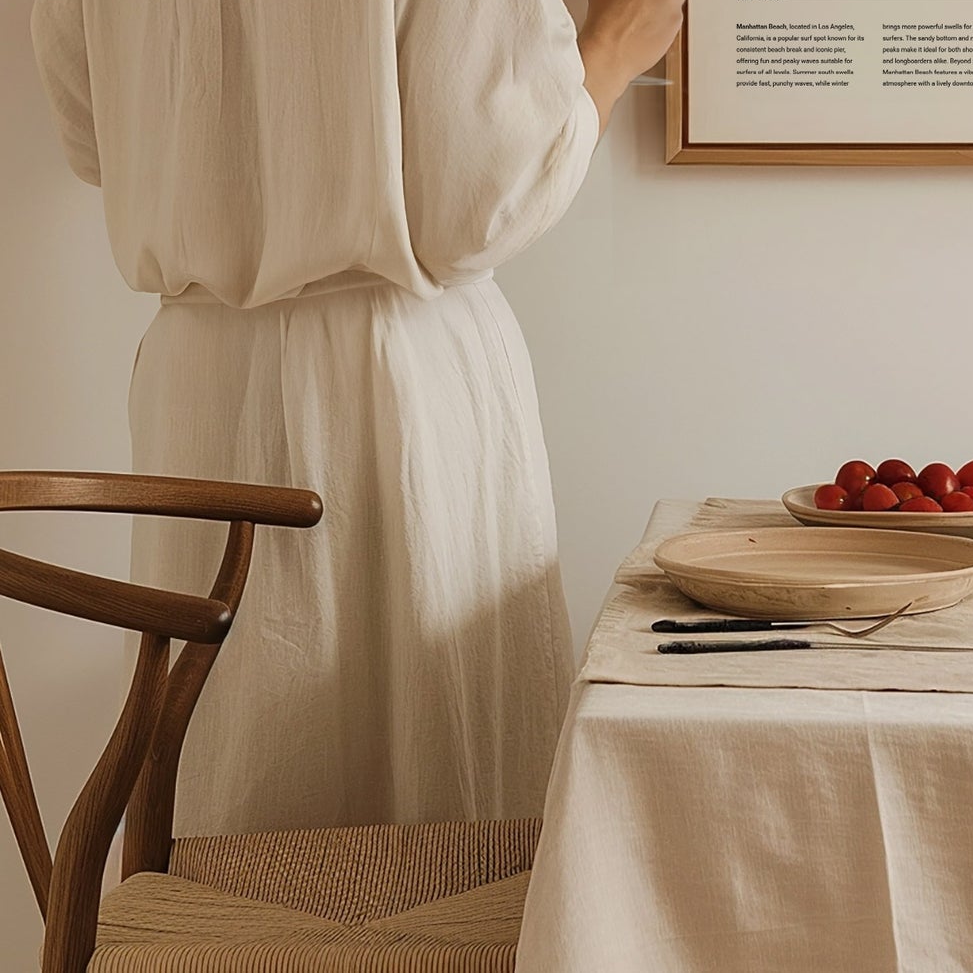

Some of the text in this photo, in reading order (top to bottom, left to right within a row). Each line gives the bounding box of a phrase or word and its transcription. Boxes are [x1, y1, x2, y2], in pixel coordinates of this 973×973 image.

[882, 23, 900, 31] brings
[918, 23, 943, 31] powerful
[777, 35, 799, 43] popular
[813, 35, 826, 43] spot
[918, 35, 935, 43] sandy
[882, 46, 900, 54] peaks
[736, 58, 759, 66] offering
[782, 58, 800, 66] peaky
[894, 58, 932, 66] longboarders
[950, 58, 971, 66] Beyond
[736, 80, 758, 88] provide
[772, 80, 793, 88] punchy
[882, 80, 917, 88] atmosphere
[936, 80, 951, 88] lively
